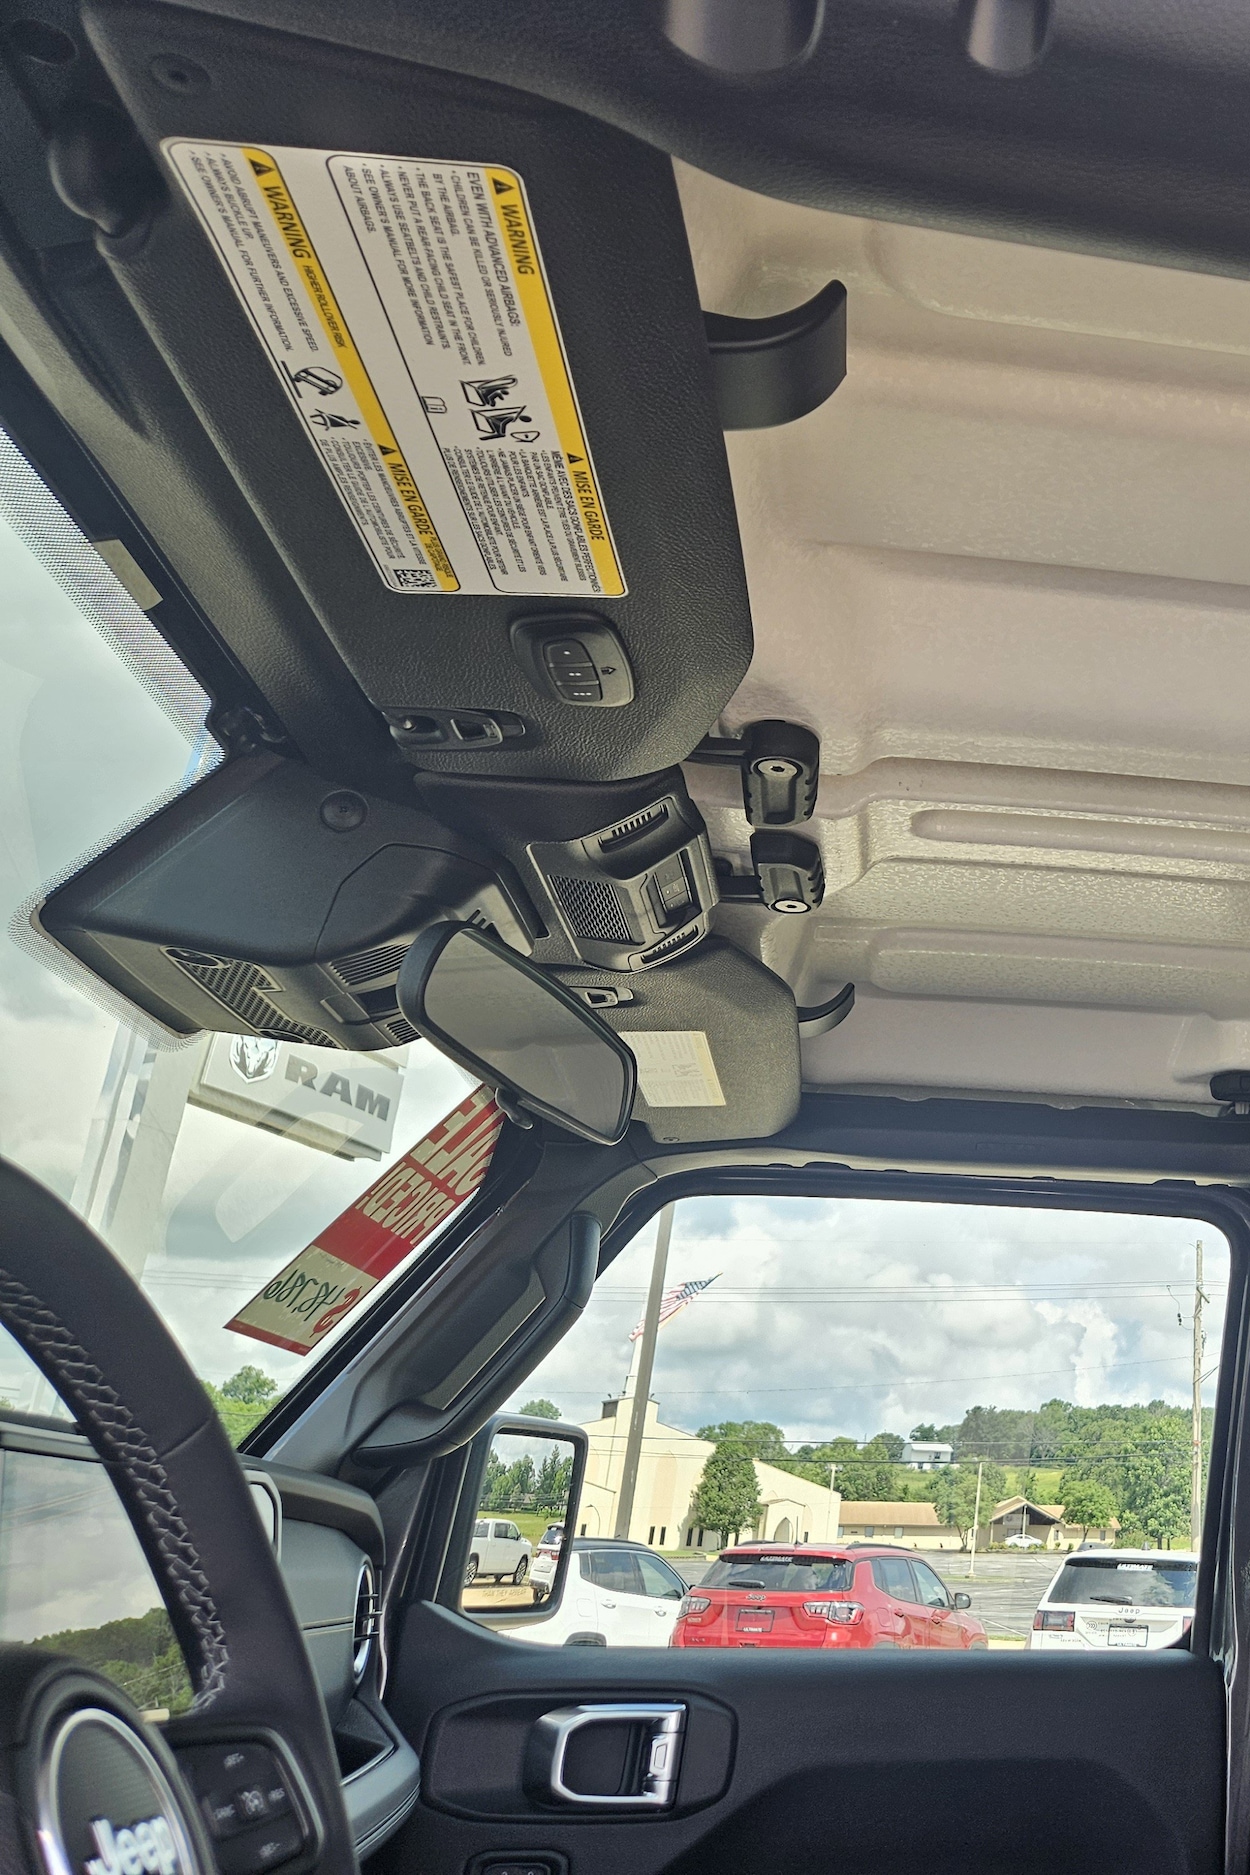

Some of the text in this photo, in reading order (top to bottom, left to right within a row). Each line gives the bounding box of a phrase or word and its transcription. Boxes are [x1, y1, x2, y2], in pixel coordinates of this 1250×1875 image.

[205, 157, 232, 192] ALWAYS
[222, 192, 249, 227] BUCKLE
[342, 165, 377, 233] ABOUT AIRBAGS.
[396, 170, 415, 199] NEVER
[406, 199, 421, 216] PUT
[431, 173, 461, 237] BY THE AIRBAG.
[189, 156, 295, 352] SEE OWNER'S MANUAL FOR FURTHER INFORMATION.
[220, 158, 320, 352] AVOID ABRUPT MANEUVERS AND EXCESSIVE SPEED.
[261, 184, 312, 258] WARNING
[360, 167, 435, 345] SEE OWNER'S MANUAL FOR MORE INFORMATION
[414, 224, 441, 276] REAR-FACING
[465, 171, 522, 327] EVEN WITH ADVANCED AIRBAGS:
[499, 202, 536, 275] WARNING
[378, 169, 451, 350] ALWAYS USE SEATBELTS AND CHILD RESTRAINTS.
[413, 172, 487, 366] THE BACK SEAT IS THE SAFEST PLACE FOR CHILDREN.
[432, 276, 449, 299] CHILD
[449, 174, 513, 356] CHILDREN CAN BE KILLED OR SERIOUSLY INJURED
[301, 265, 347, 348] HIGHER ROLLOVER RISK
[440, 300, 456, 318] SEAT
[450, 327, 463, 341] THE
[455, 342, 472, 365] FRONT.
[386, 462, 433, 535] MISE EN GARDE
[571, 470, 605, 540] MISE EN GARDE
[285, 1053, 392, 1122] RAM
[84, 1816, 176, 1875] Jeep
